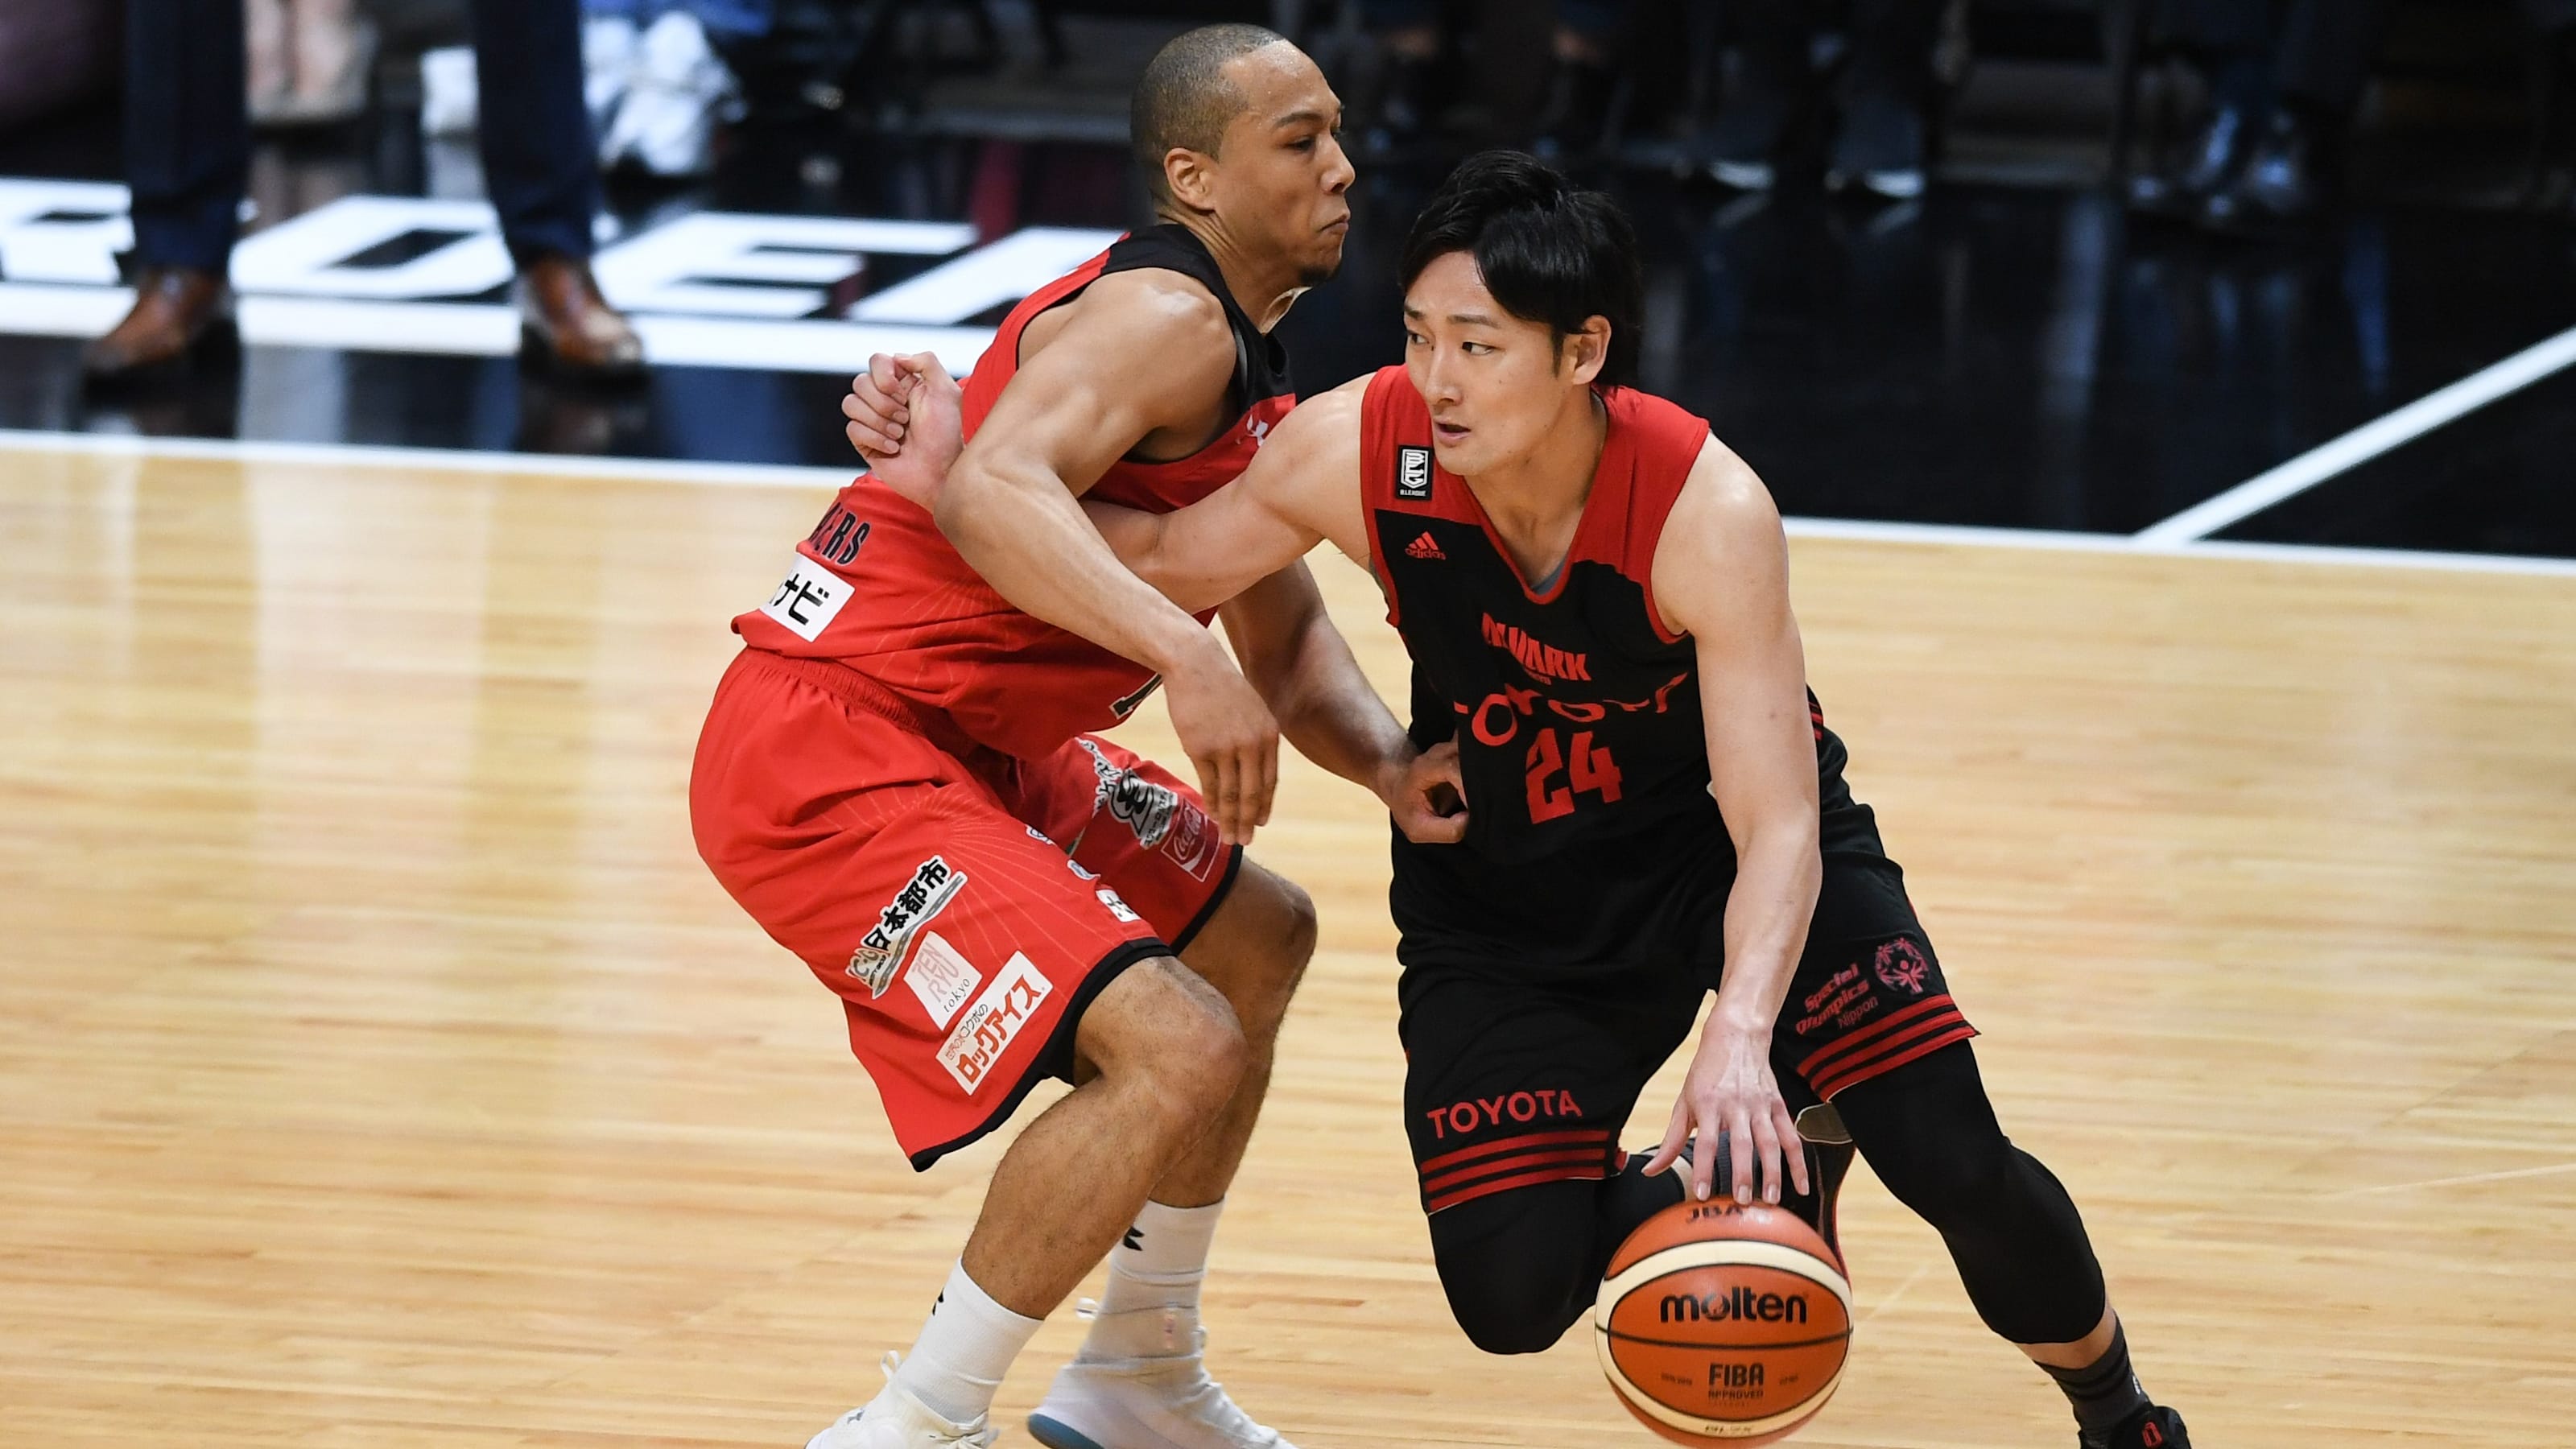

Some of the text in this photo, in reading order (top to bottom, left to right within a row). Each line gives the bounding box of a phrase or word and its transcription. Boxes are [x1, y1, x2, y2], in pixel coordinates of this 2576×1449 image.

[1404, 548, 1447, 560] adidas
[770, 573, 830, 625] ナビ
[1525, 727, 1622, 824] 24
[863, 858, 947, 952] 日本都市
[943, 978, 971, 1013] tokyo
[1805, 963, 1859, 1013] Special
[956, 974, 1042, 1084] ロックアイス
[1838, 997, 1879, 1029] Nippon
[1426, 1089, 1583, 1140] TOYOTA
[1660, 1286, 1807, 1324] molten
[1707, 1389, 1765, 1400] APPROVED
[1708, 1361, 1765, 1387] FIBA
